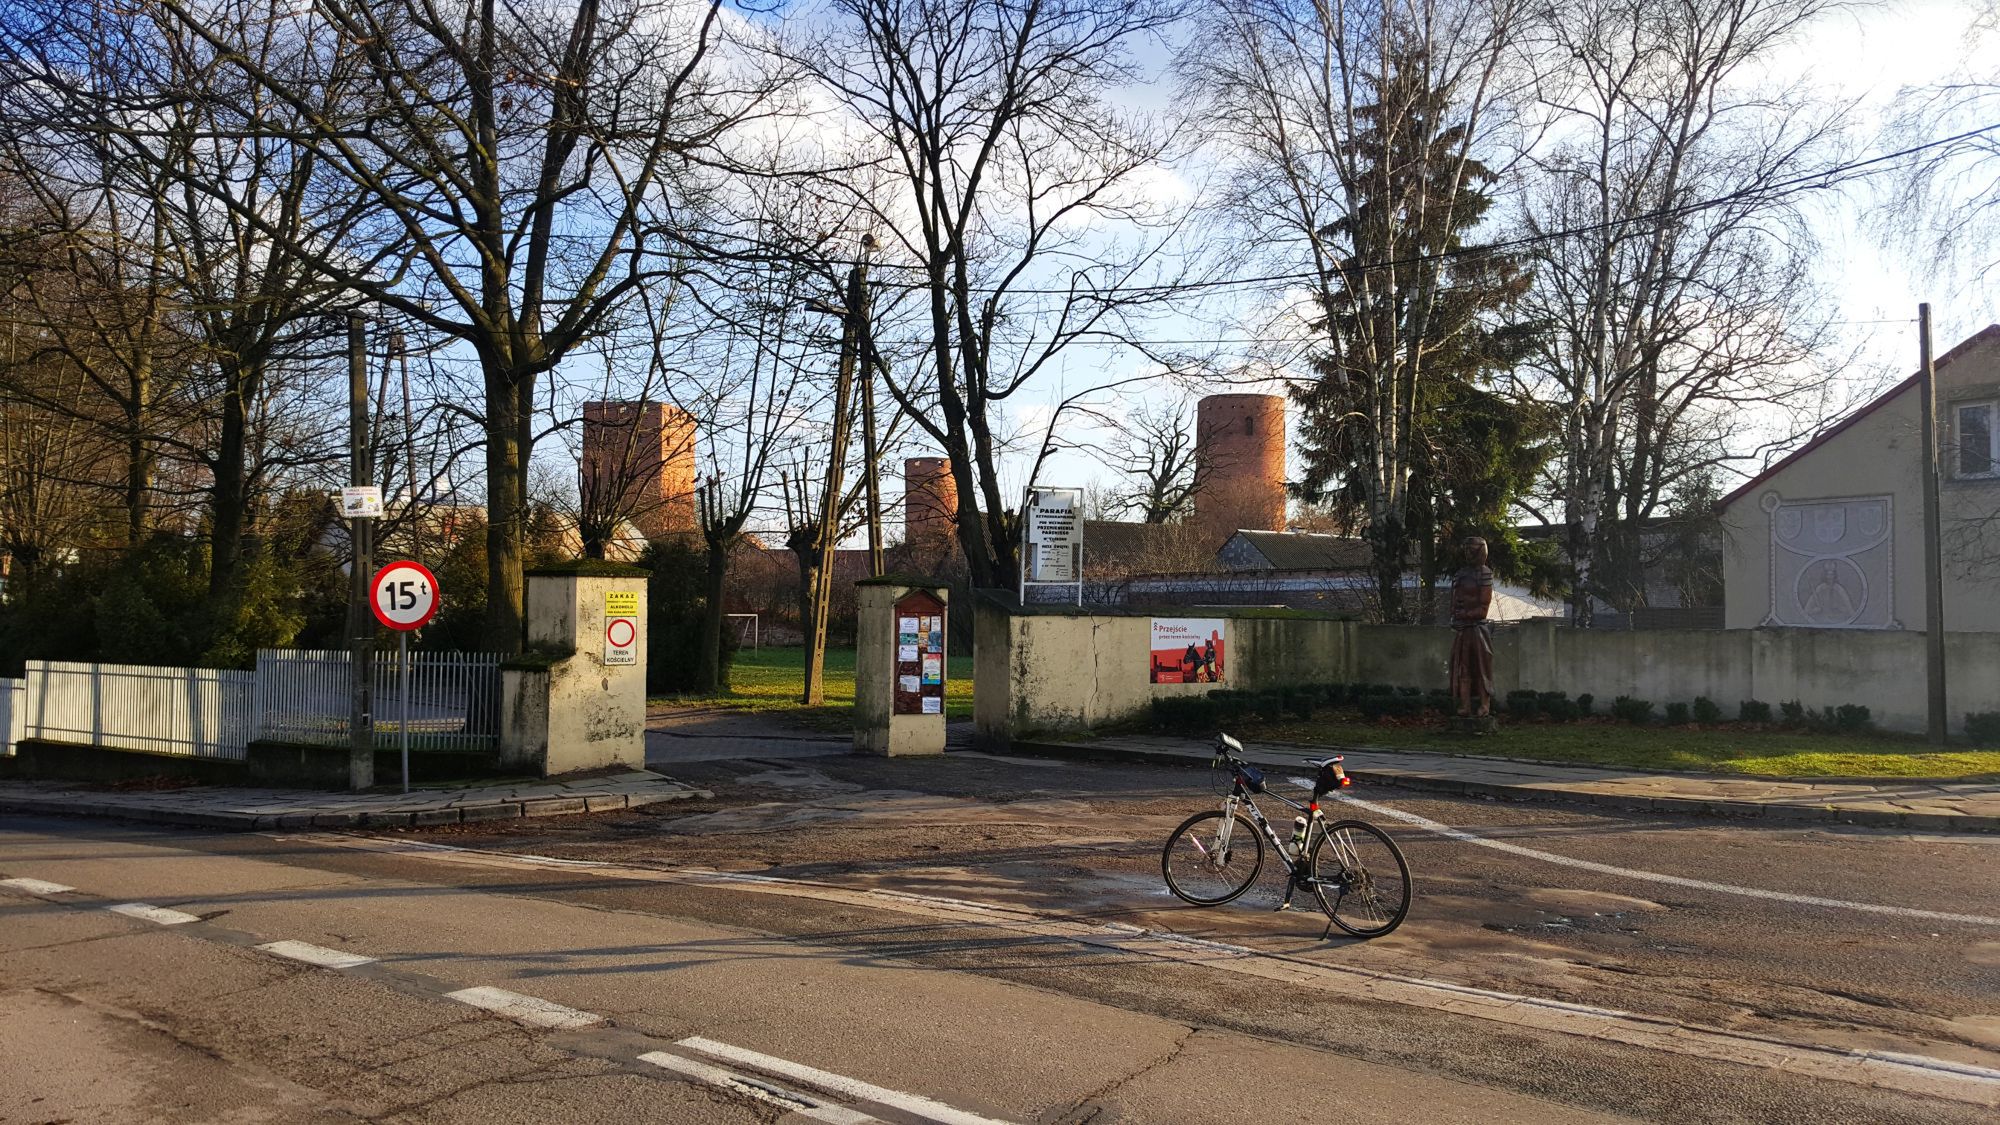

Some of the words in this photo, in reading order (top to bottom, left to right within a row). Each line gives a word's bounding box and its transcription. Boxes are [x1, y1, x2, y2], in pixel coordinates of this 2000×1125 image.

[385, 581, 417, 611] 15
[420, 581, 427, 595] t
[1158, 625, 1188, 634] Przejście
